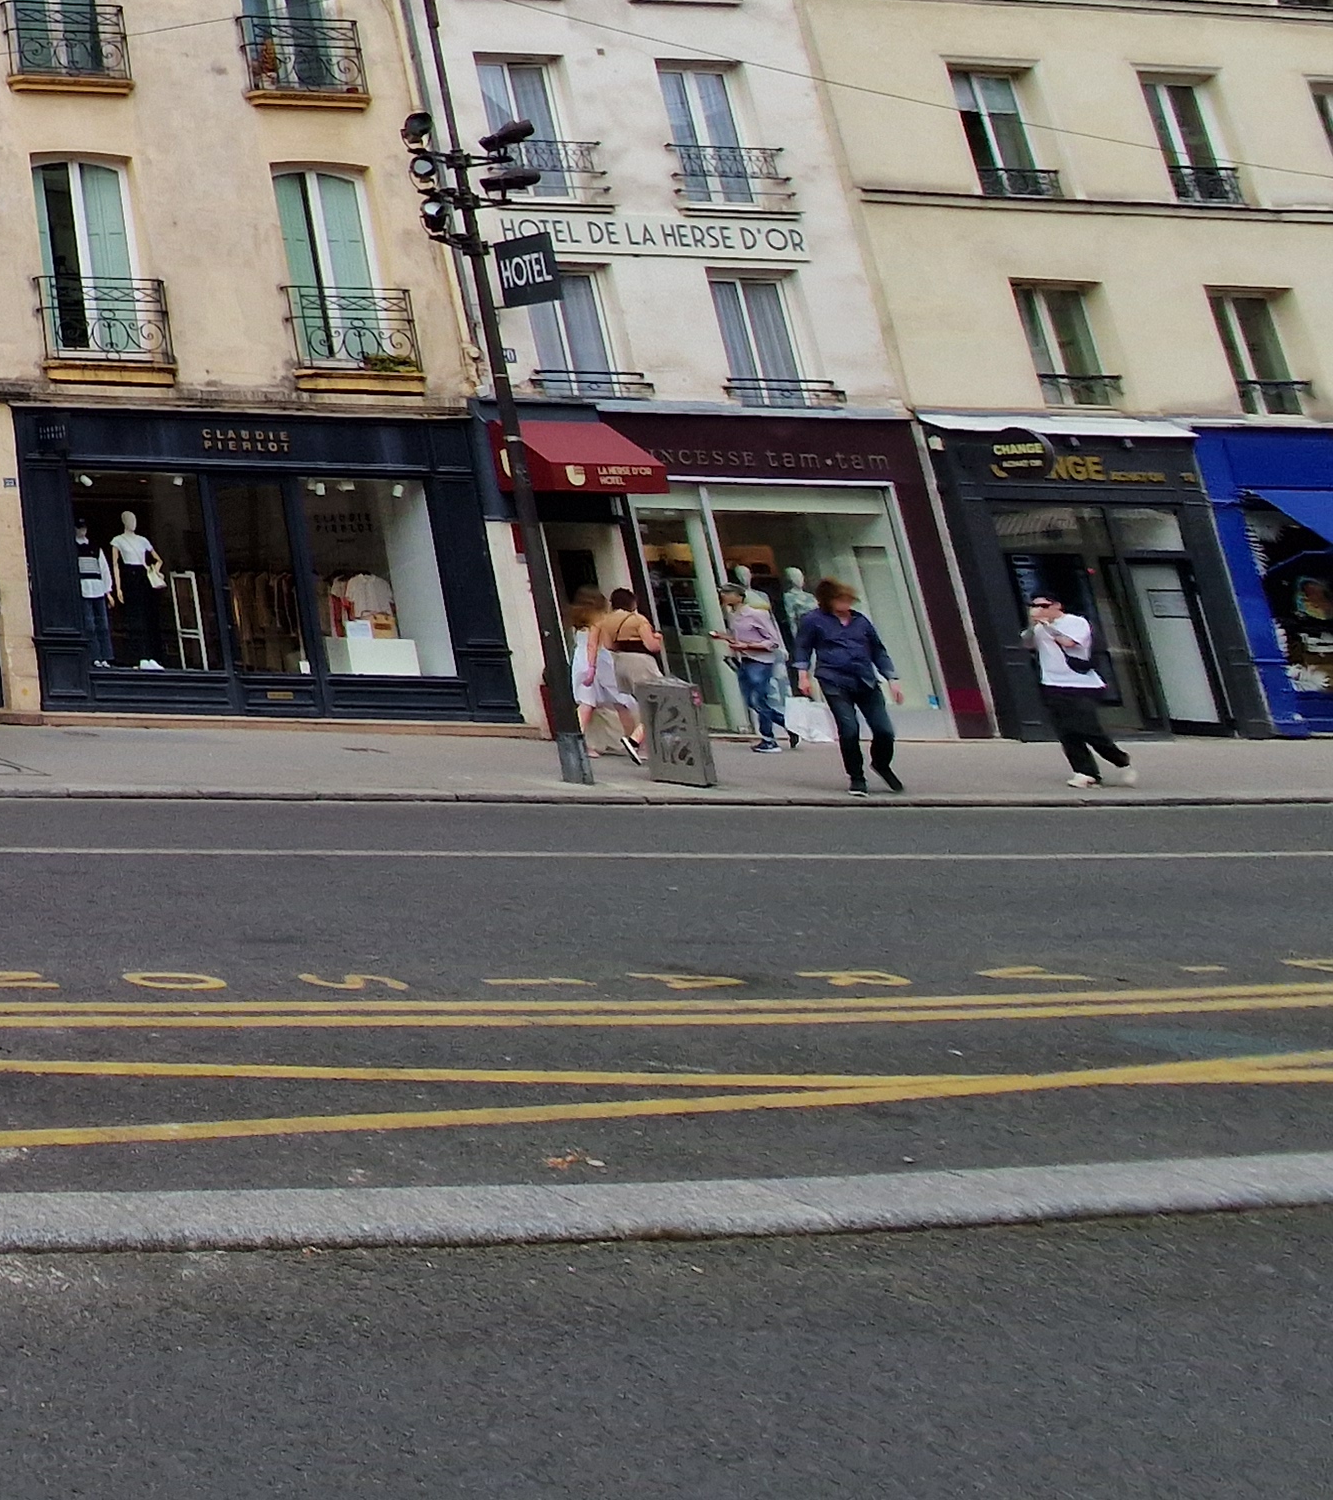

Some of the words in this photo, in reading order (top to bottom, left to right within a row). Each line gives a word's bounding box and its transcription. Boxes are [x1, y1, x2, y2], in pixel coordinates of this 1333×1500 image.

[500, 218, 581, 244] HOTEL
[587, 221, 620, 244] DE
[625, 222, 656, 246] LA
[660, 223, 735, 249] HERSE
[739, 226, 805, 251] D'OR
[500, 252, 553, 289] HOTEL
[202, 428, 290, 441] CLAUDIE
[204, 440, 290, 452] PIERLOT
[993, 443, 1044, 455] CHANGE
[597, 466, 608, 475] LA
[599, 476, 626, 486] HOTEL
